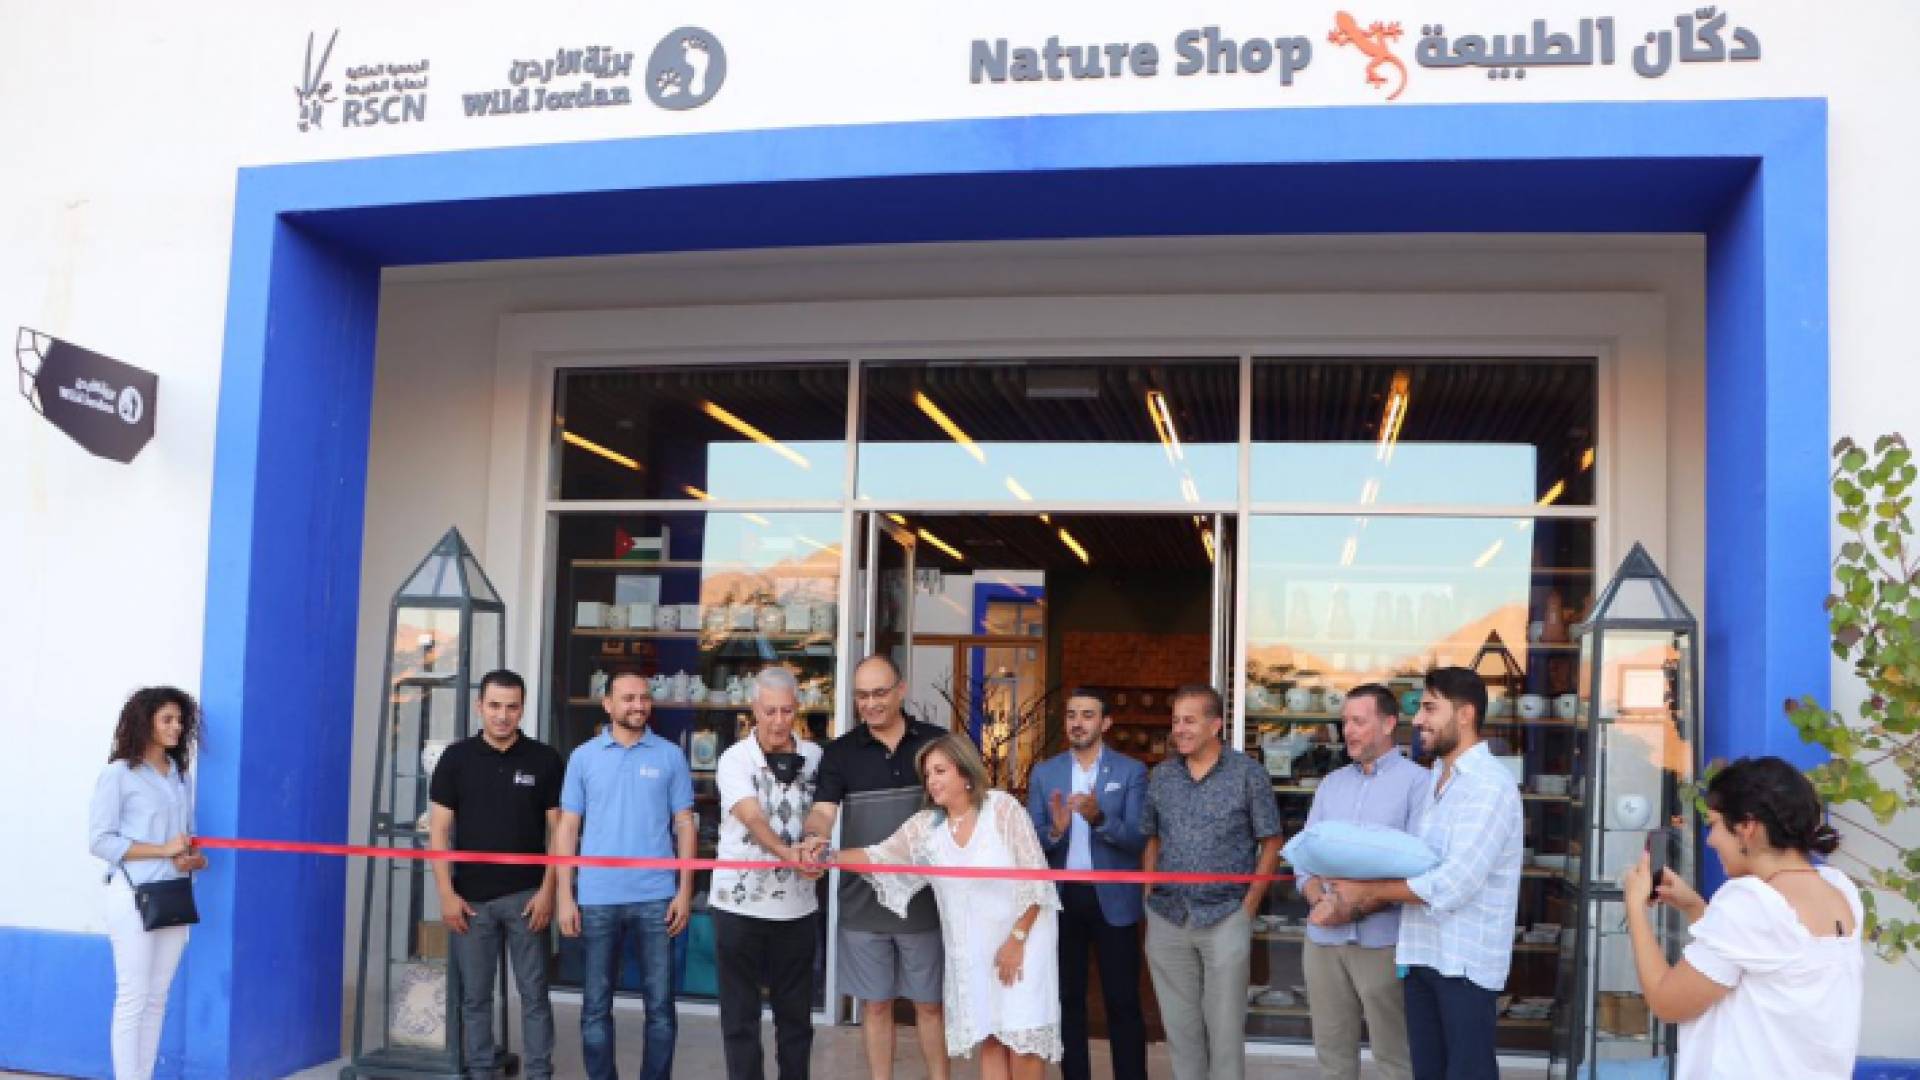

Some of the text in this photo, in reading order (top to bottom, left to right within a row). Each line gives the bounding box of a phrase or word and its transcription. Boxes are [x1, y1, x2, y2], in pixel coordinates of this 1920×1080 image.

[969, 25, 1313, 87] Nature Shop
[1414, 15, 1616, 81] الطبيعة
[342, 93, 427, 128] RSCN
[462, 81, 632, 117] Wild Jordan
